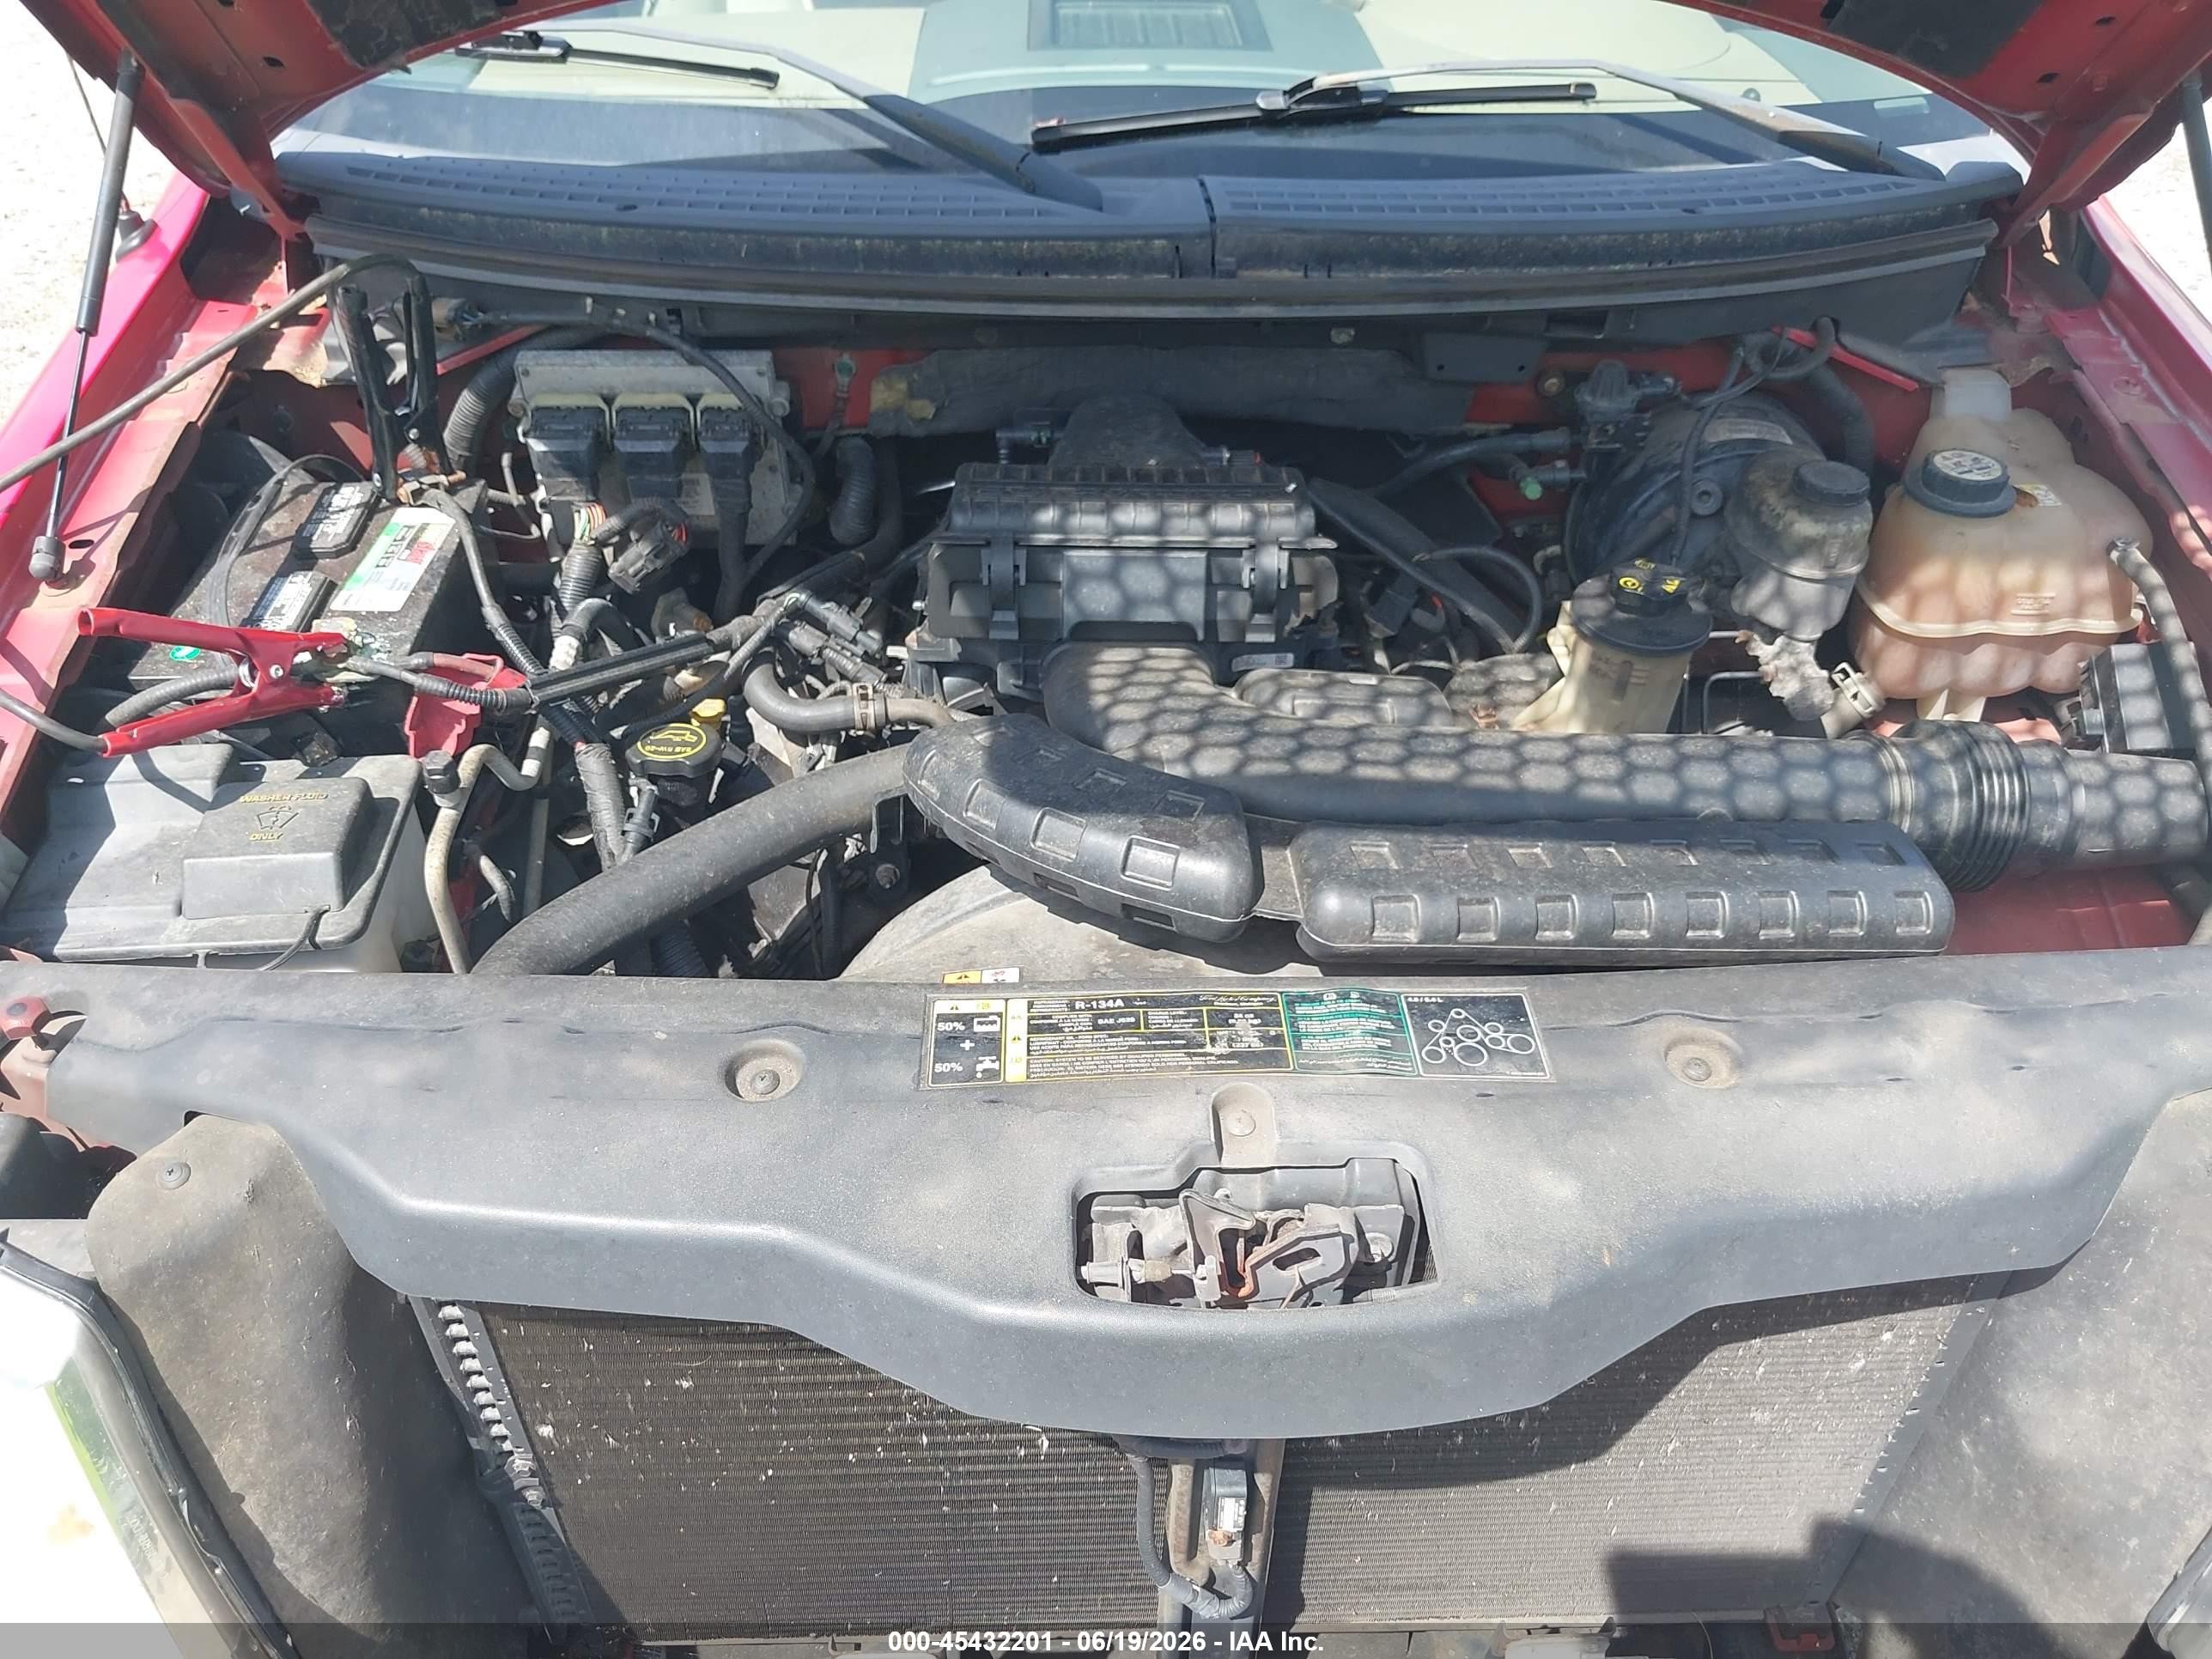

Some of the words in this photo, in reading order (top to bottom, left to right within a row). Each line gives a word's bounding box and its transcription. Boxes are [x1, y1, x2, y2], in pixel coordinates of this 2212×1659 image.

[241, 795, 292, 804] WASHER
[293, 792, 328, 800] FLUID
[249, 833, 283, 842] ONLY
[1074, 998, 1125, 1010] R-134A
[937, 1022, 965, 1031] 50%
[933, 1062, 963, 1073] 50%
